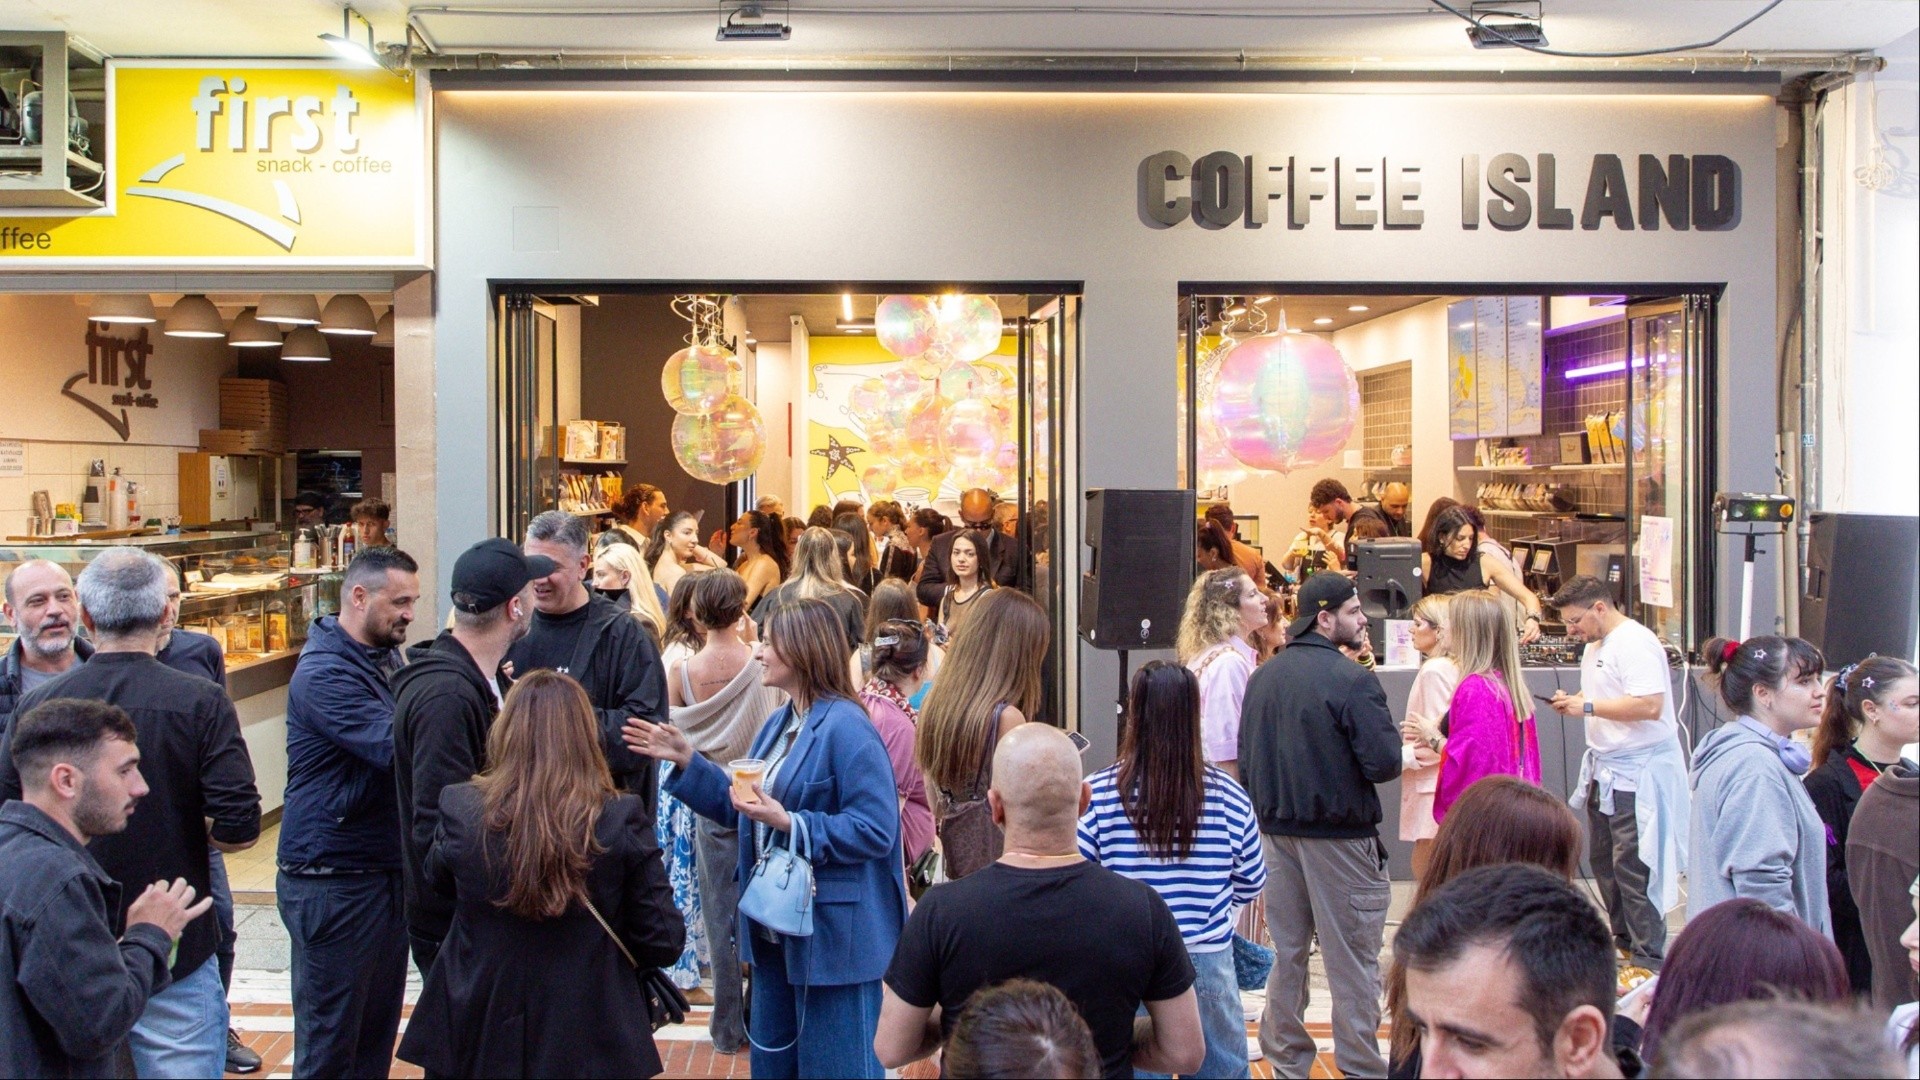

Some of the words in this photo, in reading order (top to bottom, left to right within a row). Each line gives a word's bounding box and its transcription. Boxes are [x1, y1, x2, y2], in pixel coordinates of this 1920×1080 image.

[191, 76, 360, 154] first
[256, 156, 313, 174] snack
[332, 156, 392, 174] coffee
[1141, 150, 1425, 228] COFFEE
[1461, 152, 1738, 230] ISLAND
[0, 226, 52, 250] ffee
